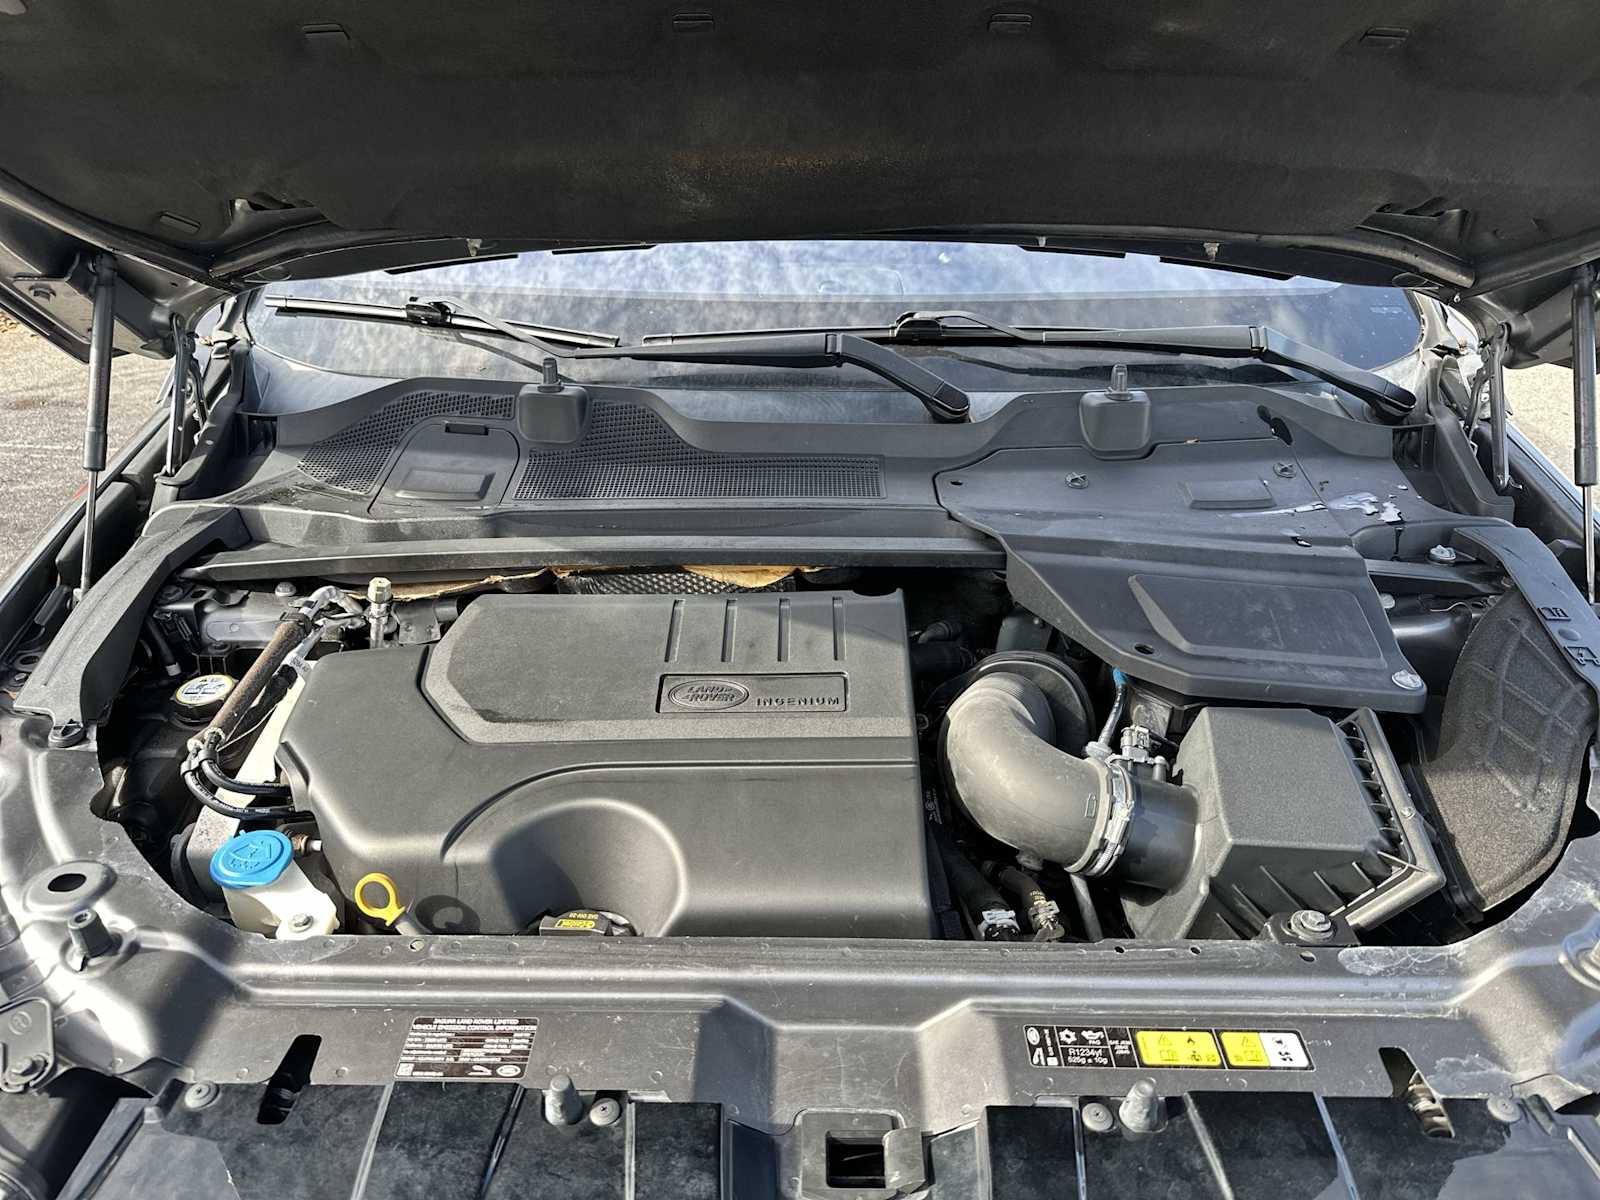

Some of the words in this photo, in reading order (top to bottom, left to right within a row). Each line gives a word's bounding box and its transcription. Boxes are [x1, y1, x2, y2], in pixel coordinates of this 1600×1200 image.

[688, 692, 736, 702] ROVER
[756, 697, 840, 706] INGENIUM
[1068, 1048, 1103, 1058] R1234yf
[1094, 1056, 1109, 1065] 10g
